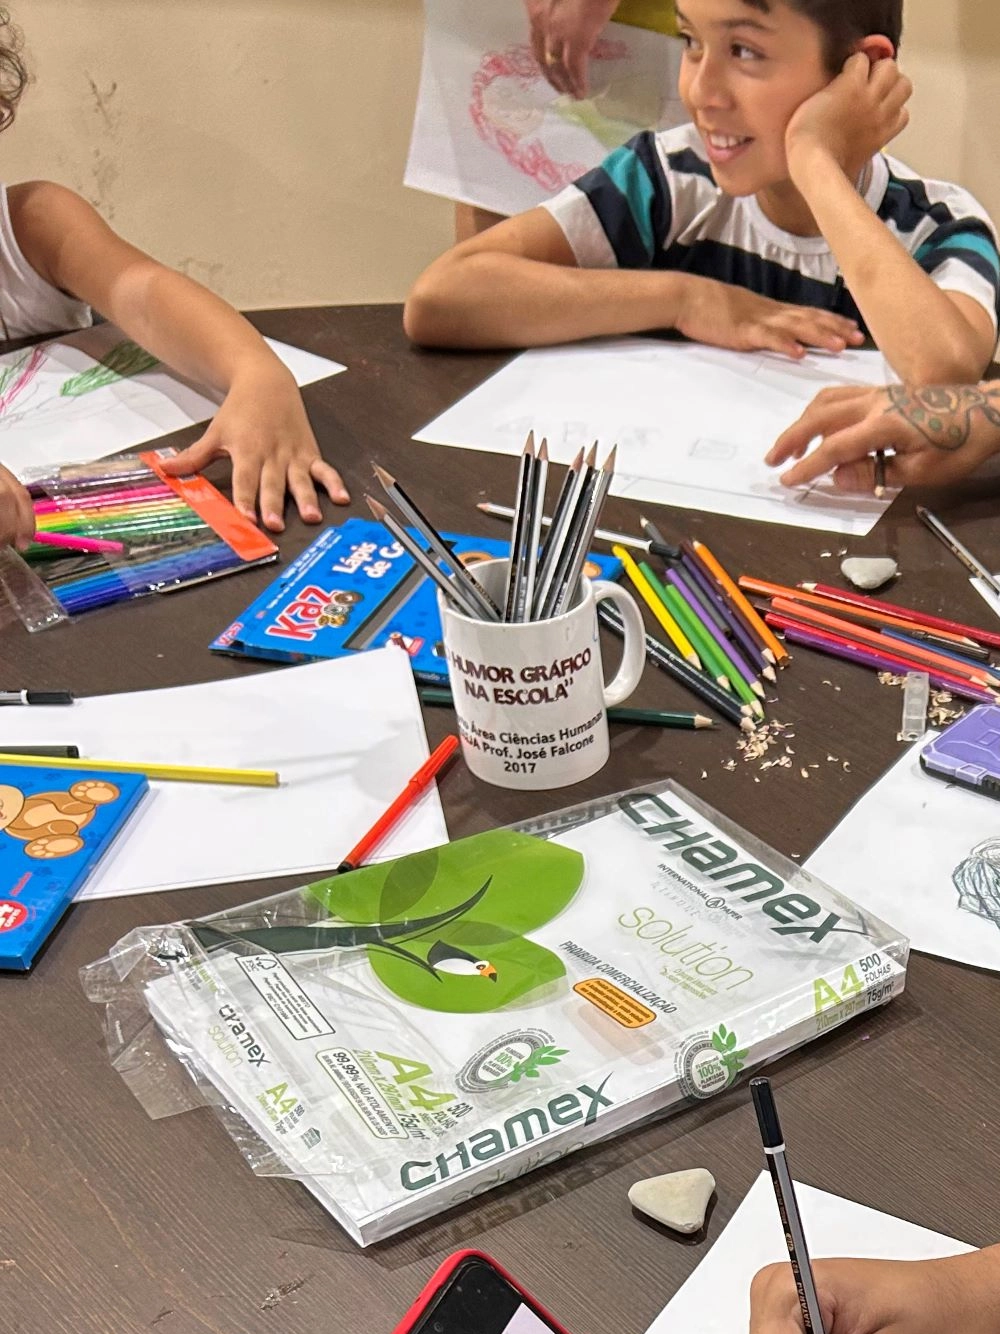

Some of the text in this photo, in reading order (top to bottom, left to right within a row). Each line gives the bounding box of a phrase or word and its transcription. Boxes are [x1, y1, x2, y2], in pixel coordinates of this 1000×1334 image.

[332, 541, 379, 575] Lápis
[363, 557, 393, 579] de
[265, 585, 332, 640] Kaz
[452, 647, 592, 684] HUMOR GRÁFICO
[464, 680, 490, 703] NA
[482, 733, 594, 760] Prof. José Falcone
[499, 730, 556, 746] Ciências
[503, 761, 537, 774] 2017
[657, 863, 743, 921] INTERNATIONAL PAPER
[618, 907, 754, 991] solution
[859, 952, 881, 973] 500
[559, 940, 602, 970] PROIBIDA
[597, 962, 678, 1015] COMERCIALIZAÇÃO
[814, 963, 865, 1015] A4
[864, 963, 892, 983] FOLHAS
[374, 1051, 458, 1111] A4
[697, 1063, 722, 1079] 100%
[265, 1082, 298, 1115] A4
[333, 1051, 362, 1081] 99,99%
[355, 1082, 372, 1096] NÃO
[364, 1094, 400, 1135] ATOLAMENTO
[446, 1102, 473, 1118] 500
